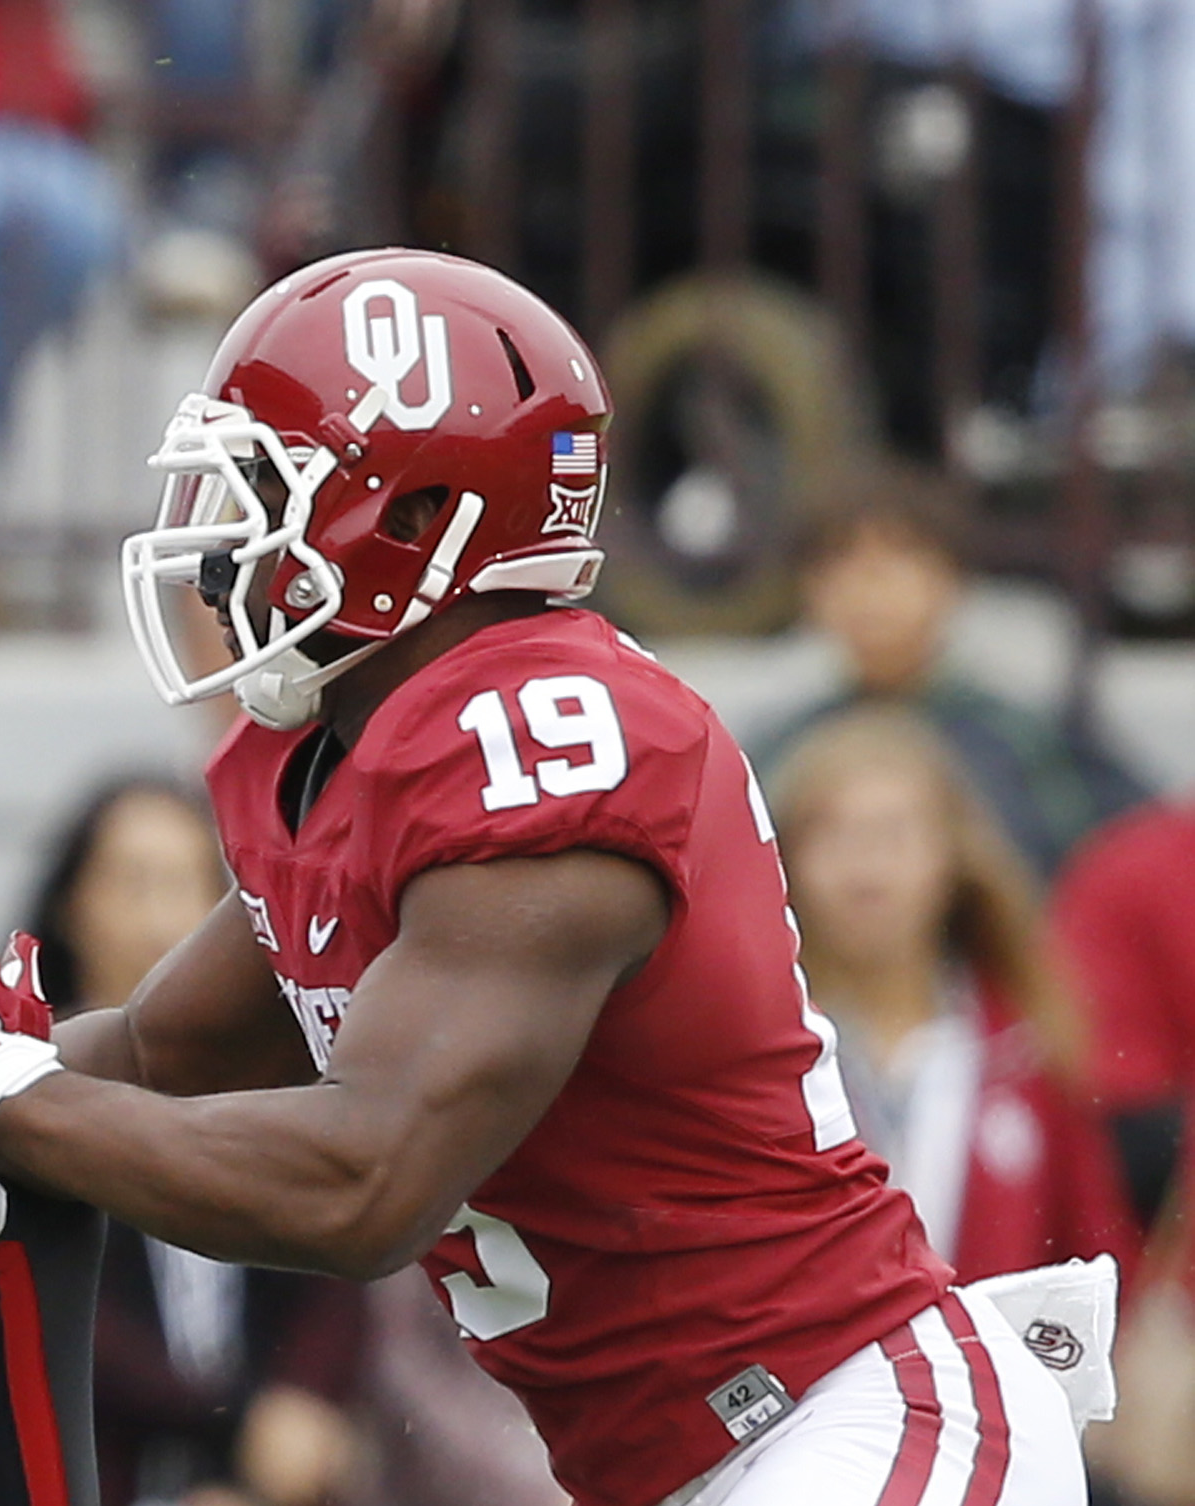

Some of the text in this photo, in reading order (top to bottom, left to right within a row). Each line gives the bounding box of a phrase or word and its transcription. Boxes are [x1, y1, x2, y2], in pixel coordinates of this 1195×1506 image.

[341, 278, 454, 431] OU
[458, 674, 628, 813] 19
[727, 1384, 756, 1409] 42
